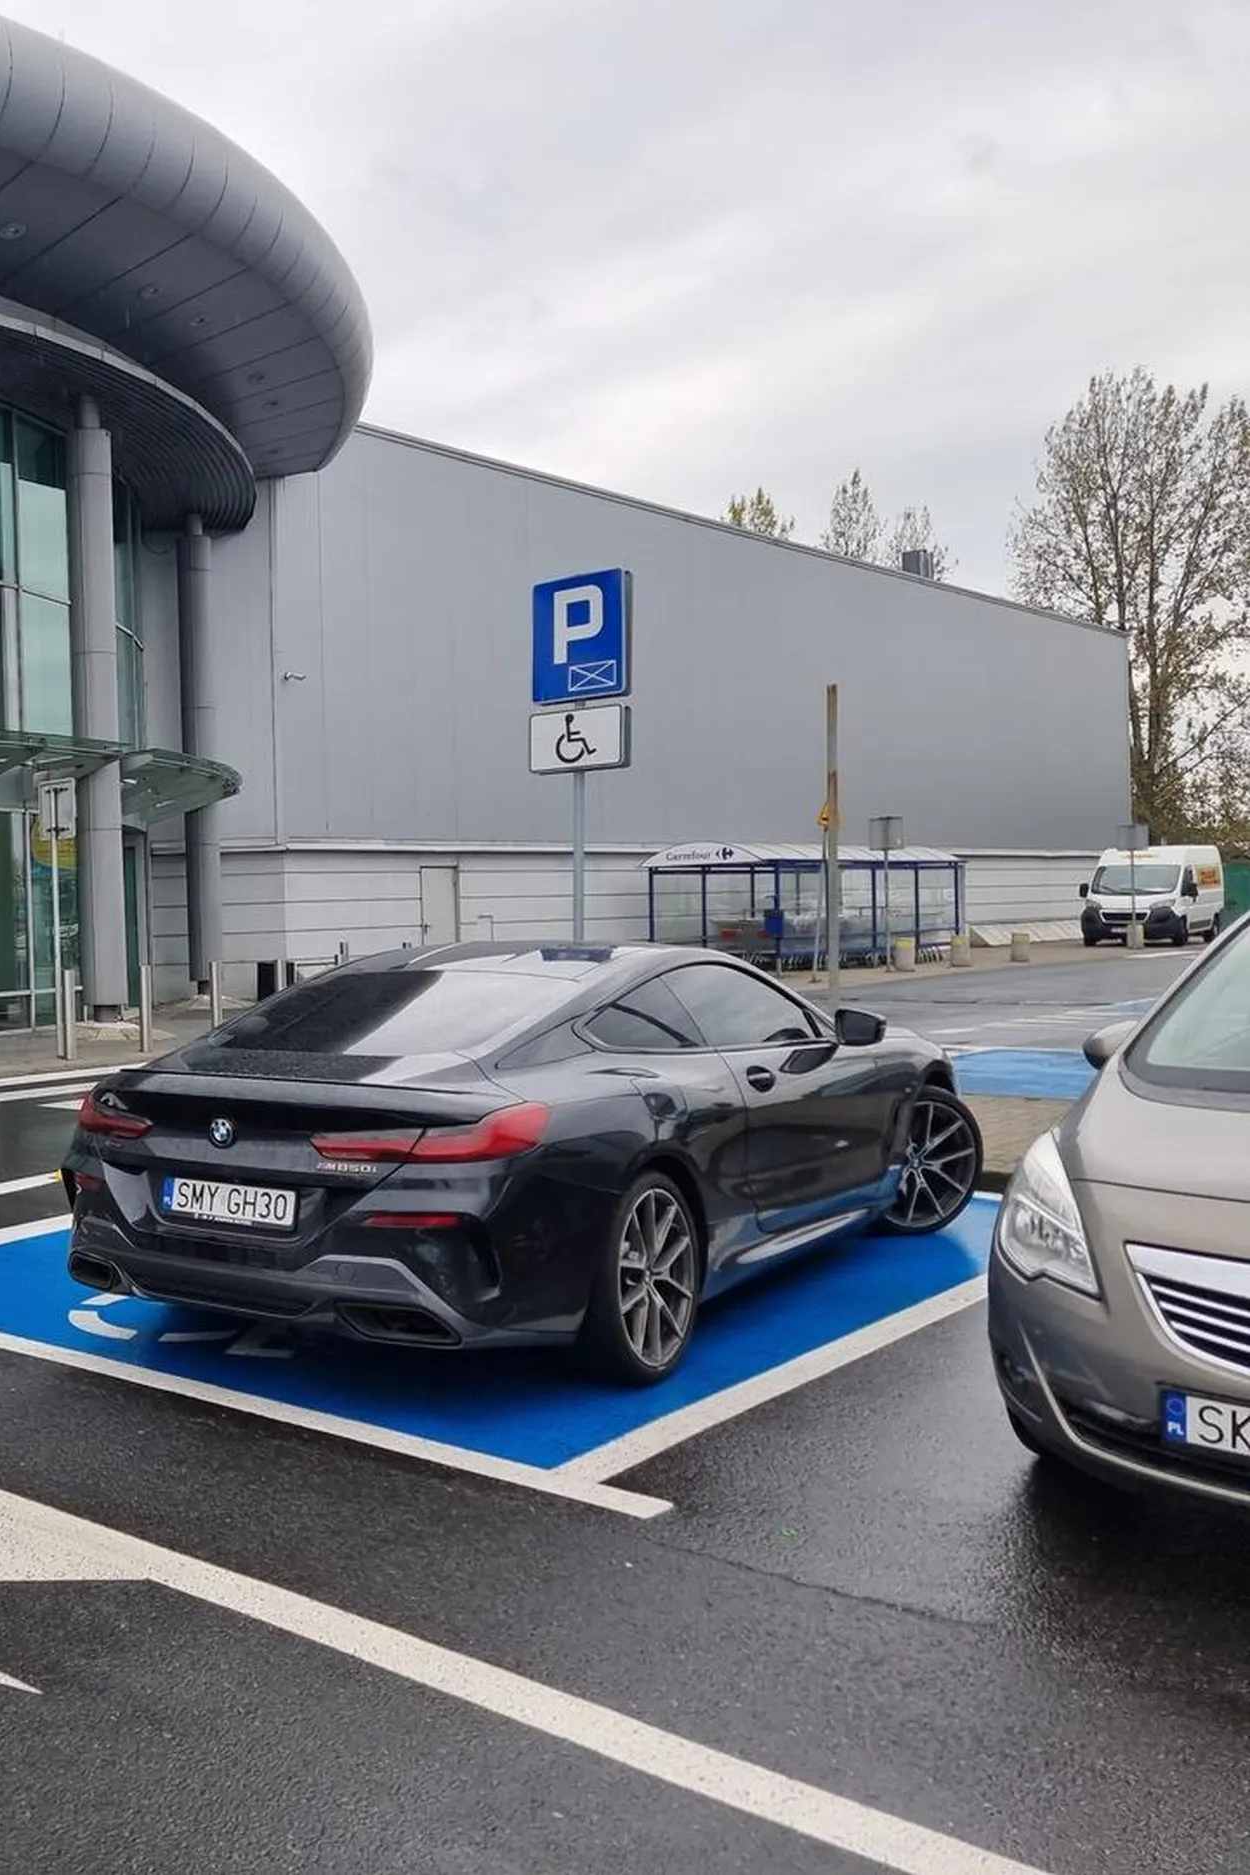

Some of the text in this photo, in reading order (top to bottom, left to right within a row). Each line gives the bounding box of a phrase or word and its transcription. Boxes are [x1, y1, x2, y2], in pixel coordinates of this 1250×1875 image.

[553, 584, 603, 665] P
[666, 850, 711, 861] Carrefour
[177, 1182, 219, 1212] SMY
[227, 1188, 288, 1221] GH30
[1167, 1421, 1184, 1436] PL
[1198, 1405, 1250, 1449] SK
